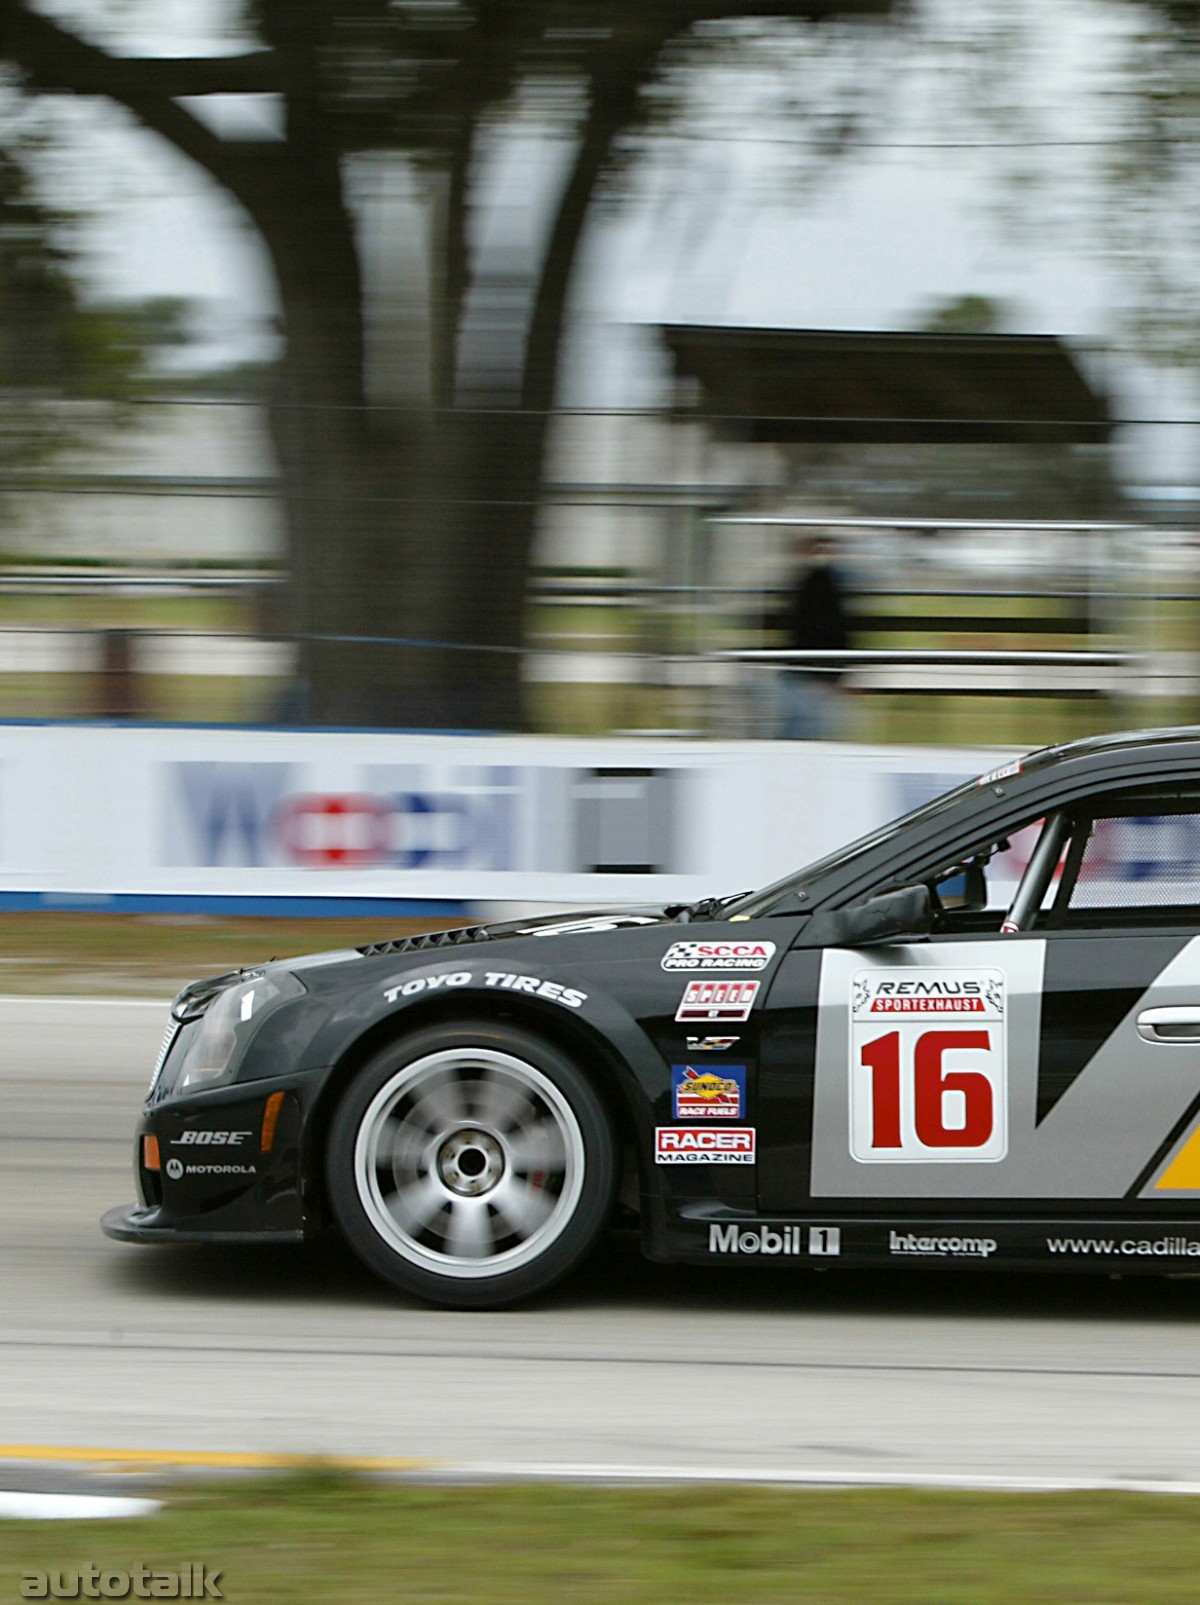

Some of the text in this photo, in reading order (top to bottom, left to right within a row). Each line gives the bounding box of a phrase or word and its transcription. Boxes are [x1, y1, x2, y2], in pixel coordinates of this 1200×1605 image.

[698, 946, 767, 956] SCCA
[665, 959, 764, 968] PRO RACING
[383, 972, 589, 1008] TOYO TIRES
[686, 990, 754, 1003] SPEED
[875, 999, 979, 1011] SPORTEXHAUST
[684, 1082, 733, 1091] SUNOCO
[861, 1030, 993, 1148] 16
[679, 1107, 738, 1116] RACE FUELS
[170, 1131, 252, 1145] BOSE
[660, 1132, 751, 1149] RACER
[657, 1153, 753, 1162] MAGAZINE
[186, 1164, 256, 1174] MOTOROLA
[709, 1224, 800, 1255] Mobil
[890, 1231, 997, 1257] Intercomp
